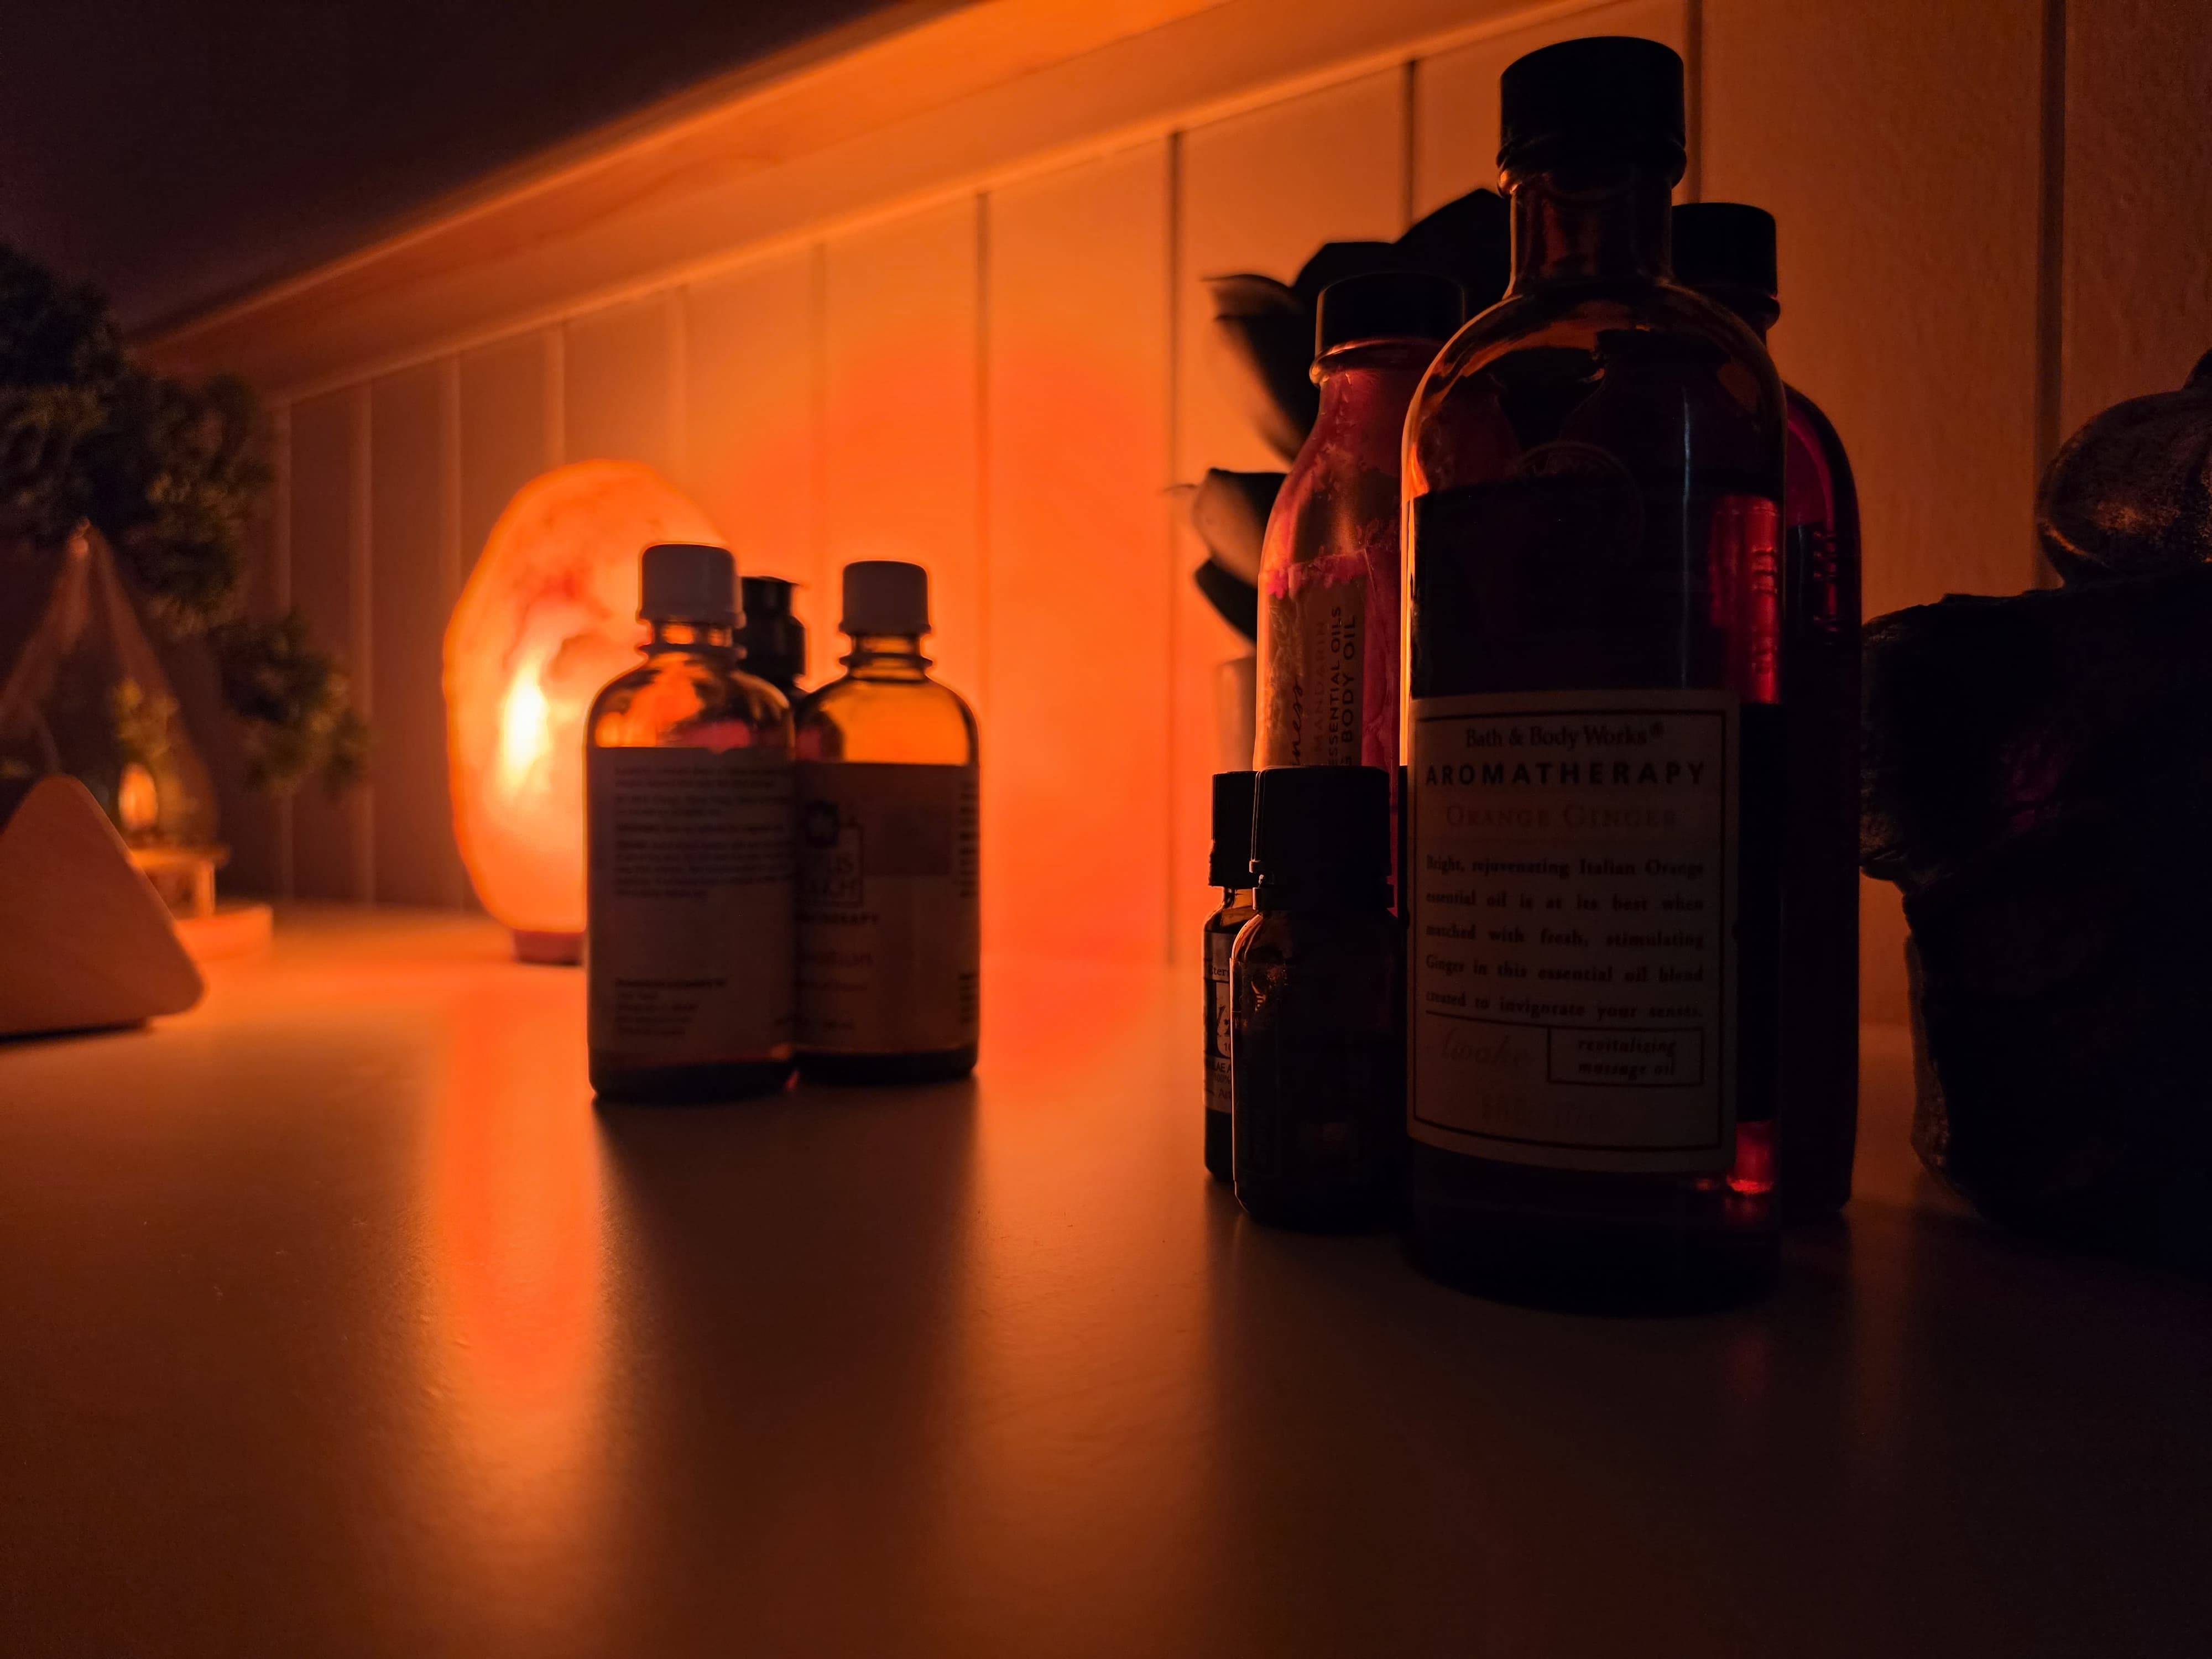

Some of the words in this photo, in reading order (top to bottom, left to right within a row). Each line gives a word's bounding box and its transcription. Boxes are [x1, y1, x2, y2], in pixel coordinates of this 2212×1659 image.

[1331, 606, 1342, 653] OILS
[1343, 614, 1357, 660] OIL
[1313, 622, 1326, 753] MANDARIN
[1341, 674, 1355, 742] BODY
[1466, 727, 1503, 748] Bath
[1508, 728, 1524, 746] &
[1530, 726, 1579, 751] Body
[1426, 760, 1706, 786] AROMATHERAPY
[1426, 854, 1465, 875] Bright,
[1472, 858, 1570, 879] rejuvenating
[1579, 859, 1636, 876] Italian
[1645, 859, 1704, 879] Orange
[1426, 889, 1476, 906] essential
[1486, 891, 1507, 907] oil
[1519, 892, 1532, 909] is
[1546, 896, 1562, 909] at
[1577, 894, 1597, 911] its
[1613, 894, 1648, 911] best
[1662, 895, 1704, 911] when
[1488, 926, 1525, 943] with
[1540, 927, 1589, 948] fresh,
[1605, 931, 1704, 951] stimulating
[1426, 954, 1464, 975] Ginger
[1473, 960, 1488, 975] in
[1497, 961, 1527, 978] this
[1538, 966, 1613, 982] essential
[1625, 967, 1647, 983] oil
[1659, 965, 1704, 983] blend
[1426, 991, 1467, 1007] created
[1475, 997, 1489, 1009] to
[1500, 996, 1585, 1018] invigorate
[1597, 1004, 1636, 1021] your
[1648, 1004, 1703, 1019] senses.
[1578, 1039, 1676, 1057] revitalizing
[1578, 1061, 1646, 1081] massage
[1653, 1058, 1675, 1076] oil
